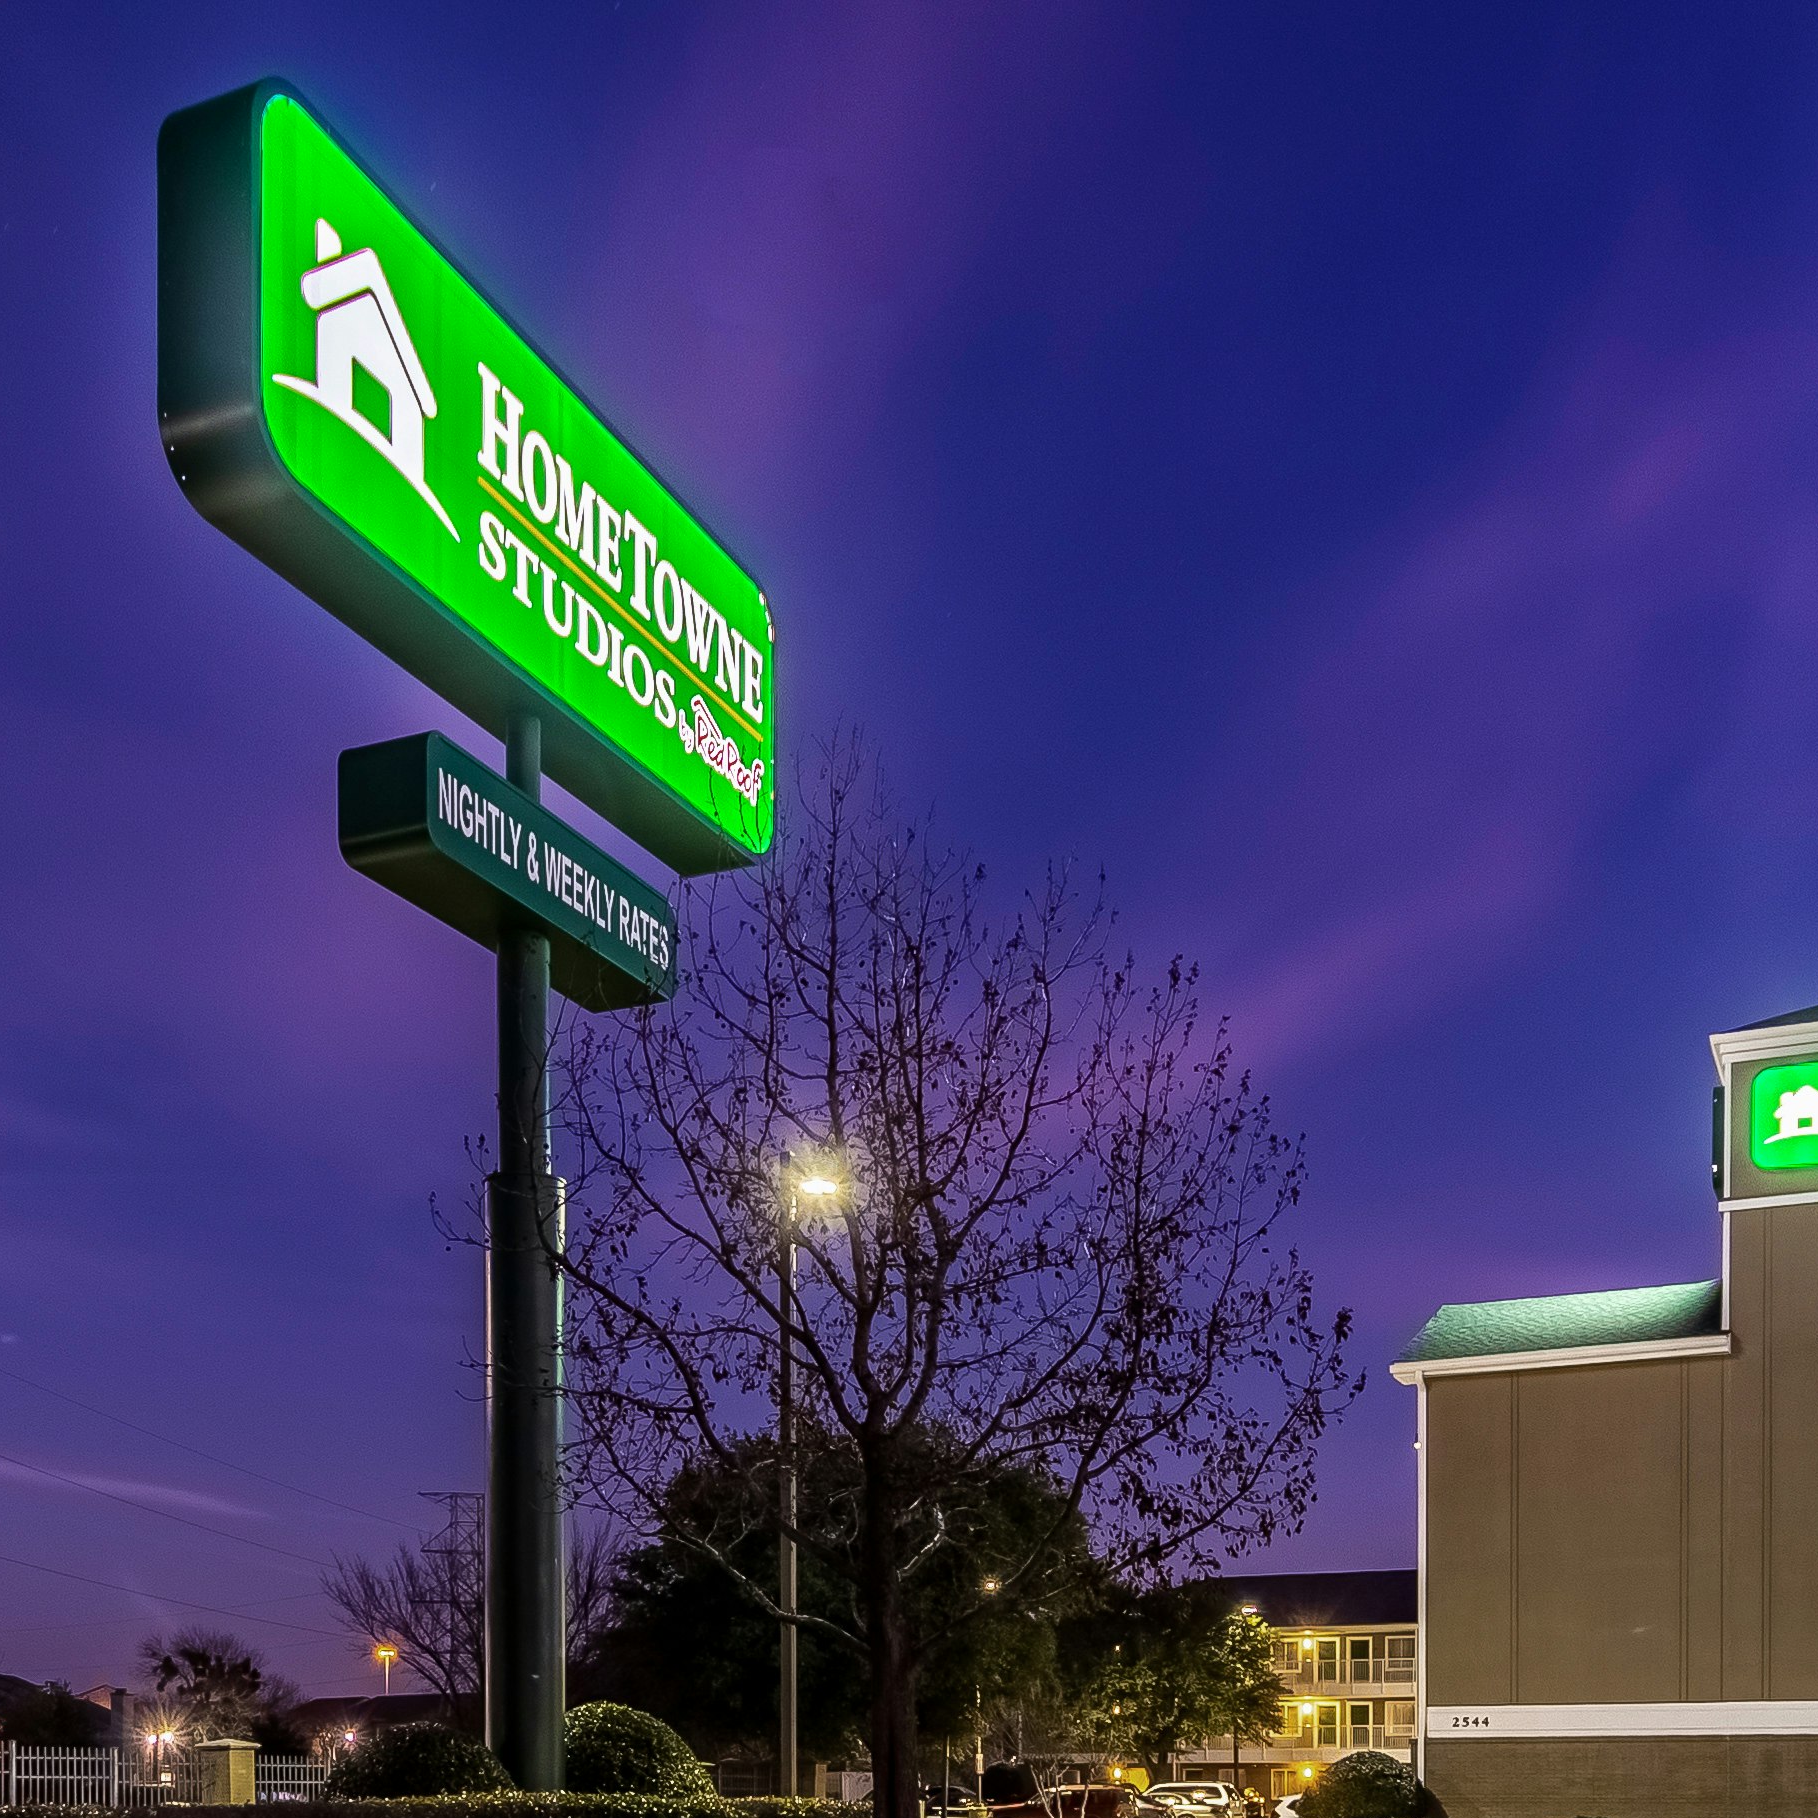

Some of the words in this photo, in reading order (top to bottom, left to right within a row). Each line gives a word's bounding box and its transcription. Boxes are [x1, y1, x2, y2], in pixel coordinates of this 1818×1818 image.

[477, 361, 764, 723] HOMETOWNE
[478, 510, 677, 729] STUDIOS
[438, 767, 522, 870] NIGHTLY
[526, 831, 540, 885] &
[544, 841, 615, 933] WEEKLY
[619, 895, 670, 971] RATES
[1452, 1716, 1490, 1728] 2544
